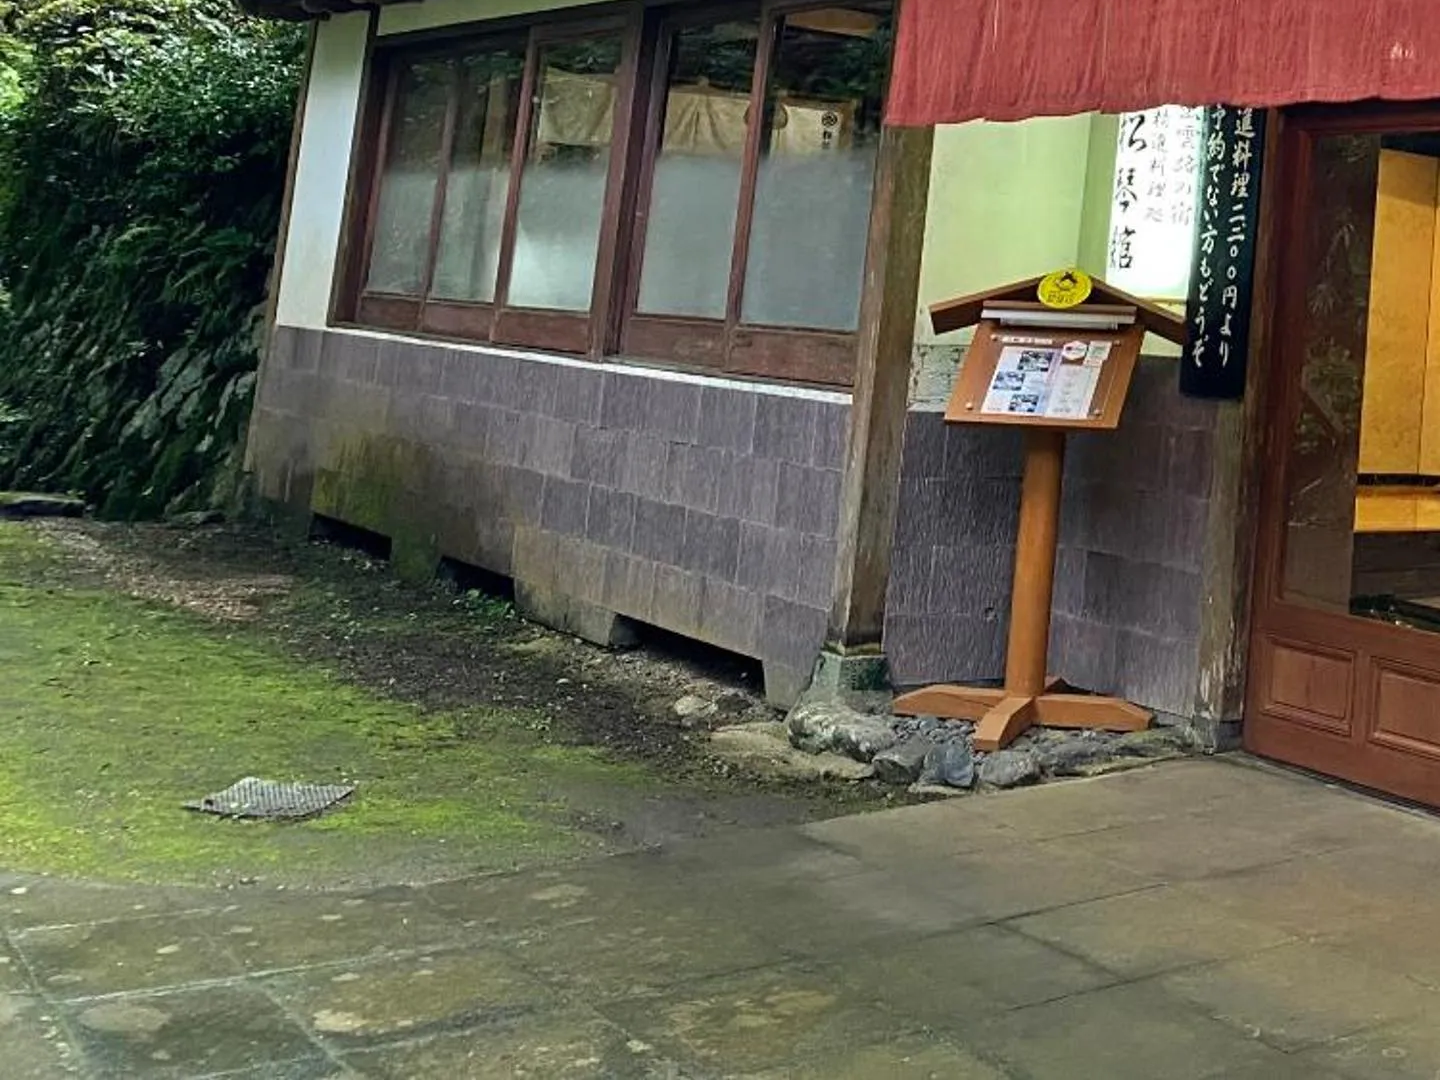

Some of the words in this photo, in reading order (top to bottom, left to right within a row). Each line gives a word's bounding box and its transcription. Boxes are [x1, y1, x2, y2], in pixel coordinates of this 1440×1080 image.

[1192, 104, 1227, 368] 予約でない方もどうぞ
